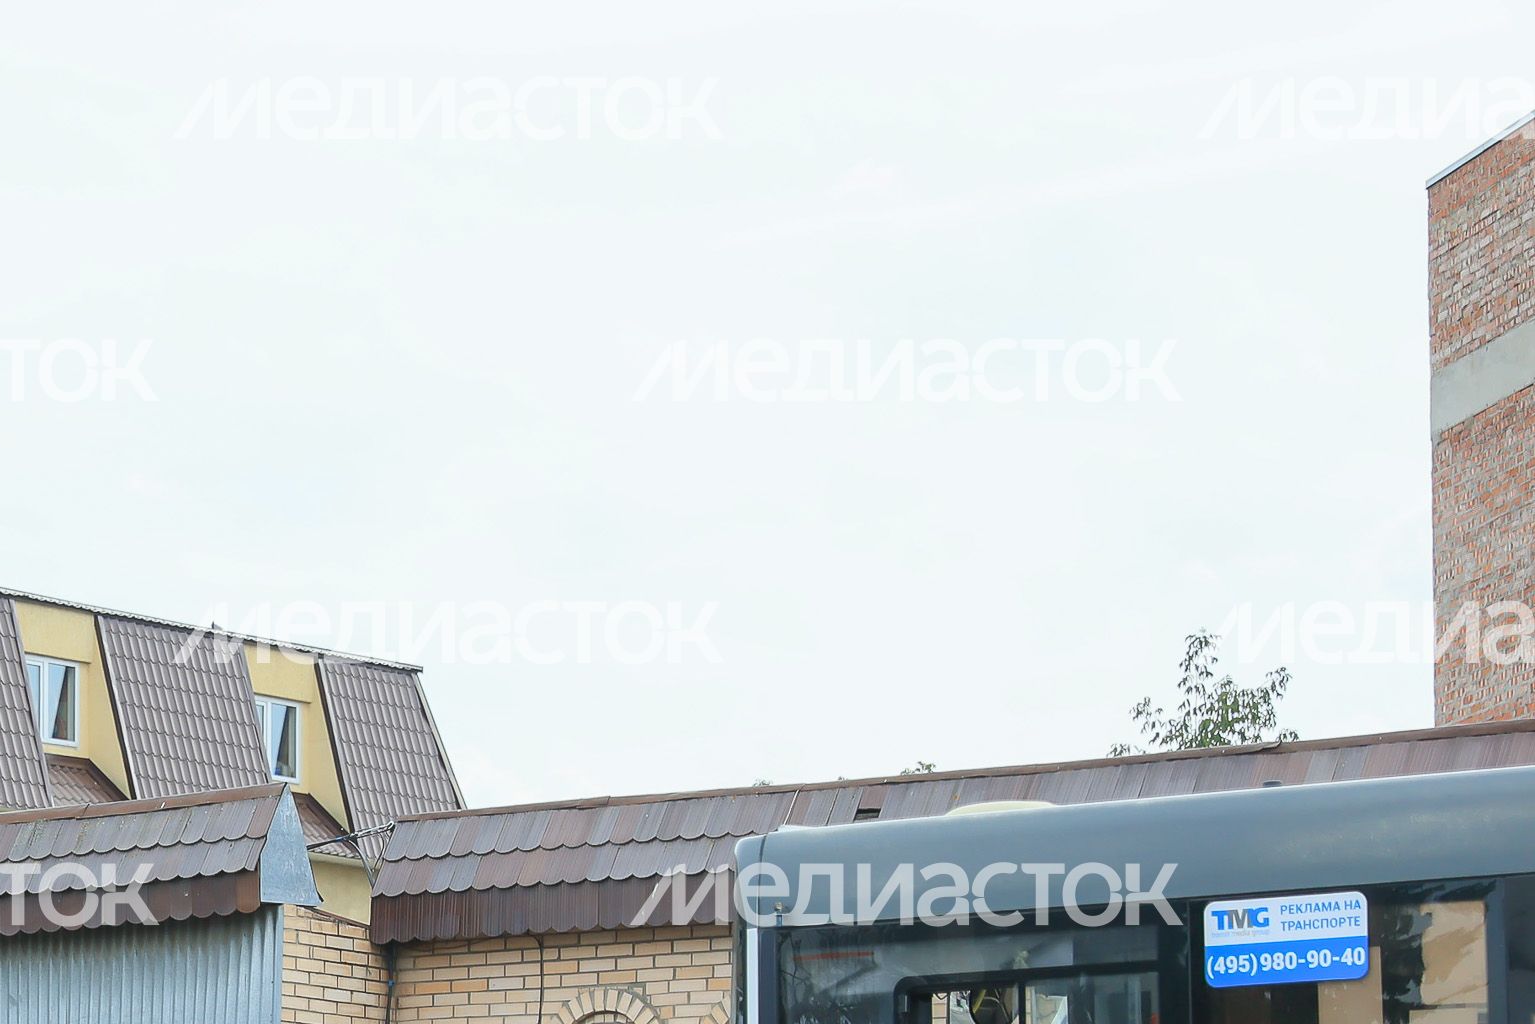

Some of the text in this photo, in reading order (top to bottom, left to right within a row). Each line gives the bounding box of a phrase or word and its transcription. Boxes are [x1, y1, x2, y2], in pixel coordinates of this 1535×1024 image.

[1280, 899, 1361, 915] РЕКЛАМА НА
[1211, 907, 1270, 931] TMG
[1280, 916, 1361, 932] ТРАНСПОРТЕ
